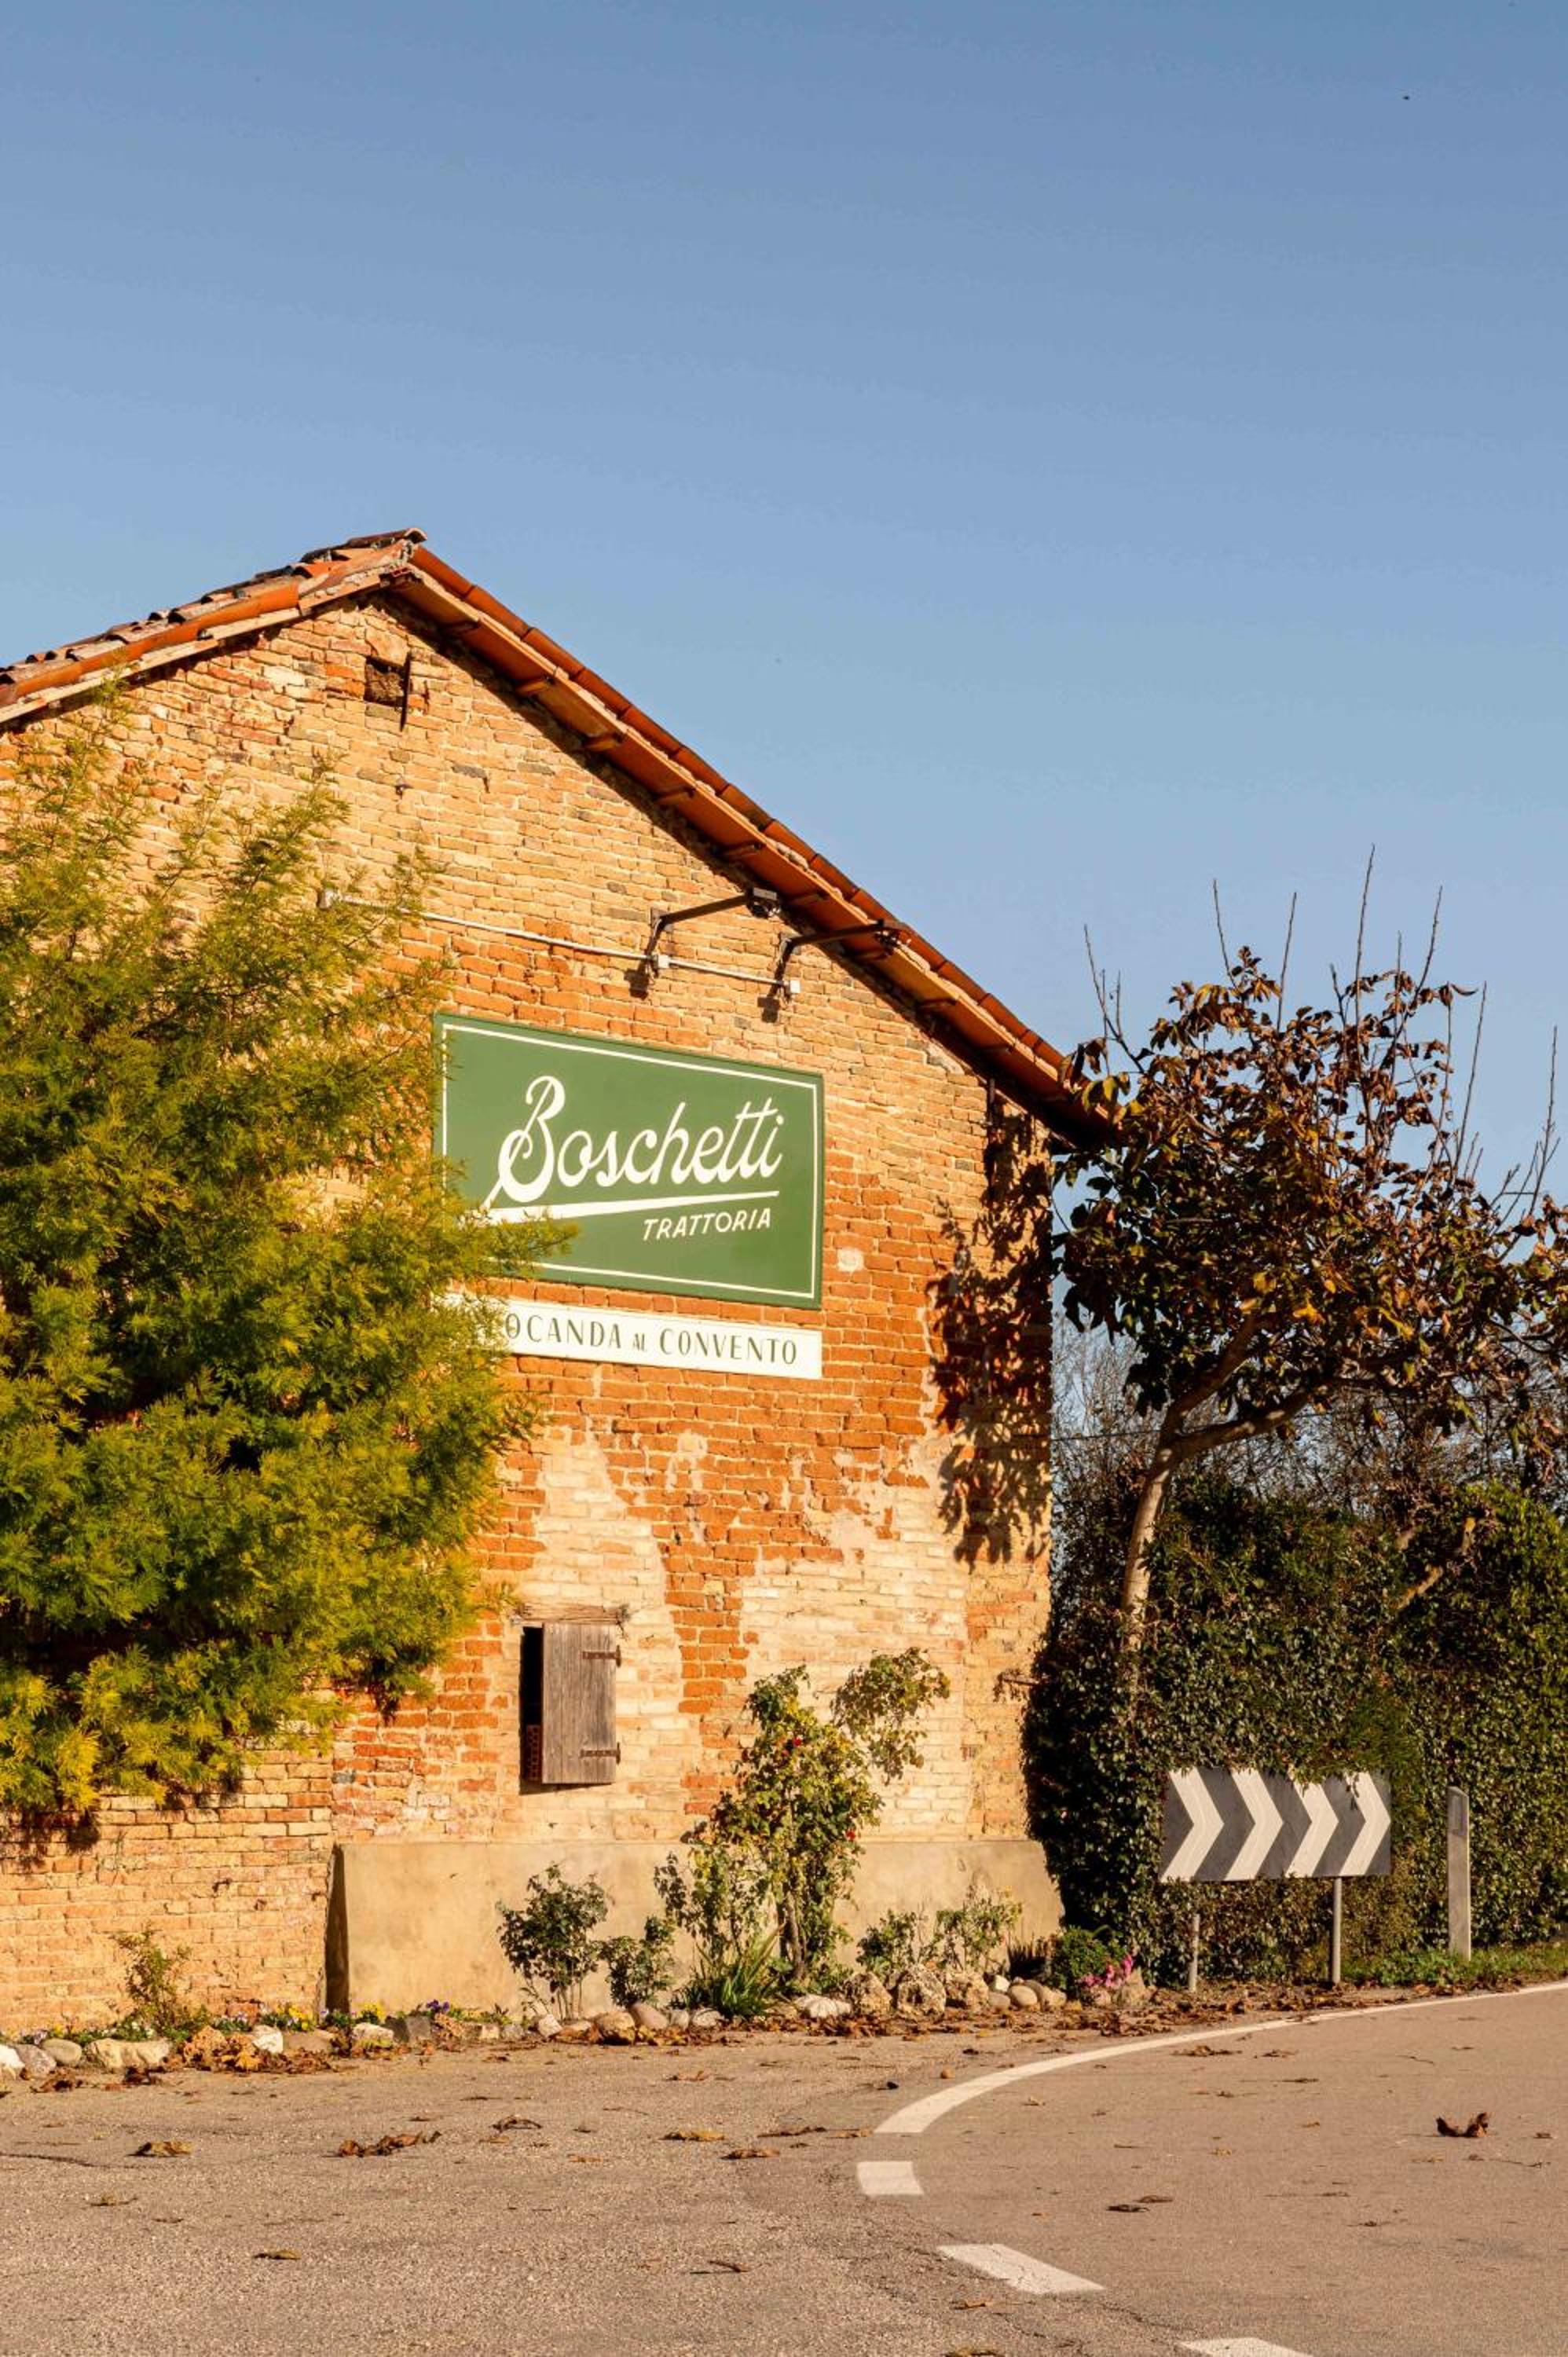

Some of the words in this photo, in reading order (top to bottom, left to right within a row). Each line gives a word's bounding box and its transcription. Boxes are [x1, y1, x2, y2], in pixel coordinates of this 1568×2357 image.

[482, 1075, 785, 1210] Boschetti
[643, 1208, 771, 1241] TRATTORIA
[504, 1312, 621, 1350] OCANDA
[660, 1328, 797, 1365] CONVENTO
